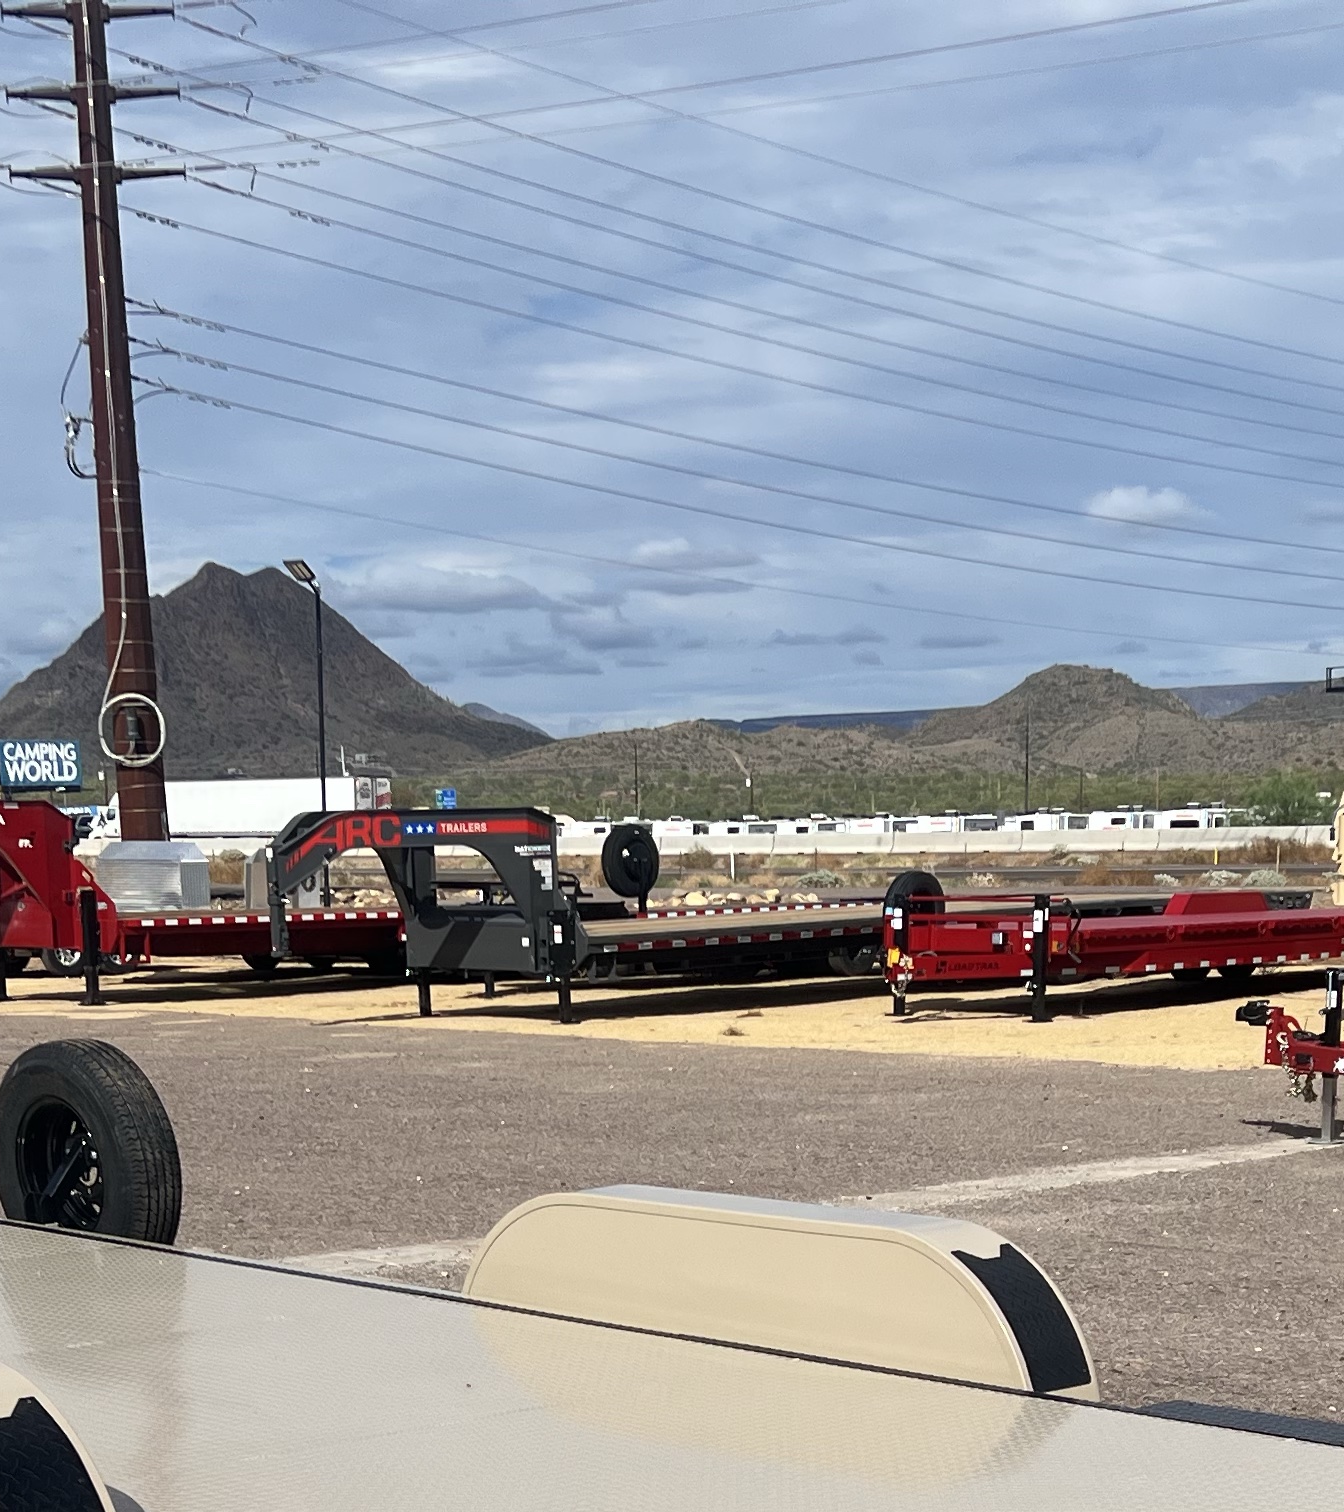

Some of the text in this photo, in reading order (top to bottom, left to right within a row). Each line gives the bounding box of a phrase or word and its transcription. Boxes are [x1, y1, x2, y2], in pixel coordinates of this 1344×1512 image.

[3, 743, 77, 761] CAMPING
[5, 761, 77, 782] WORLD
[288, 809, 488, 862] ARC TRAILERS
